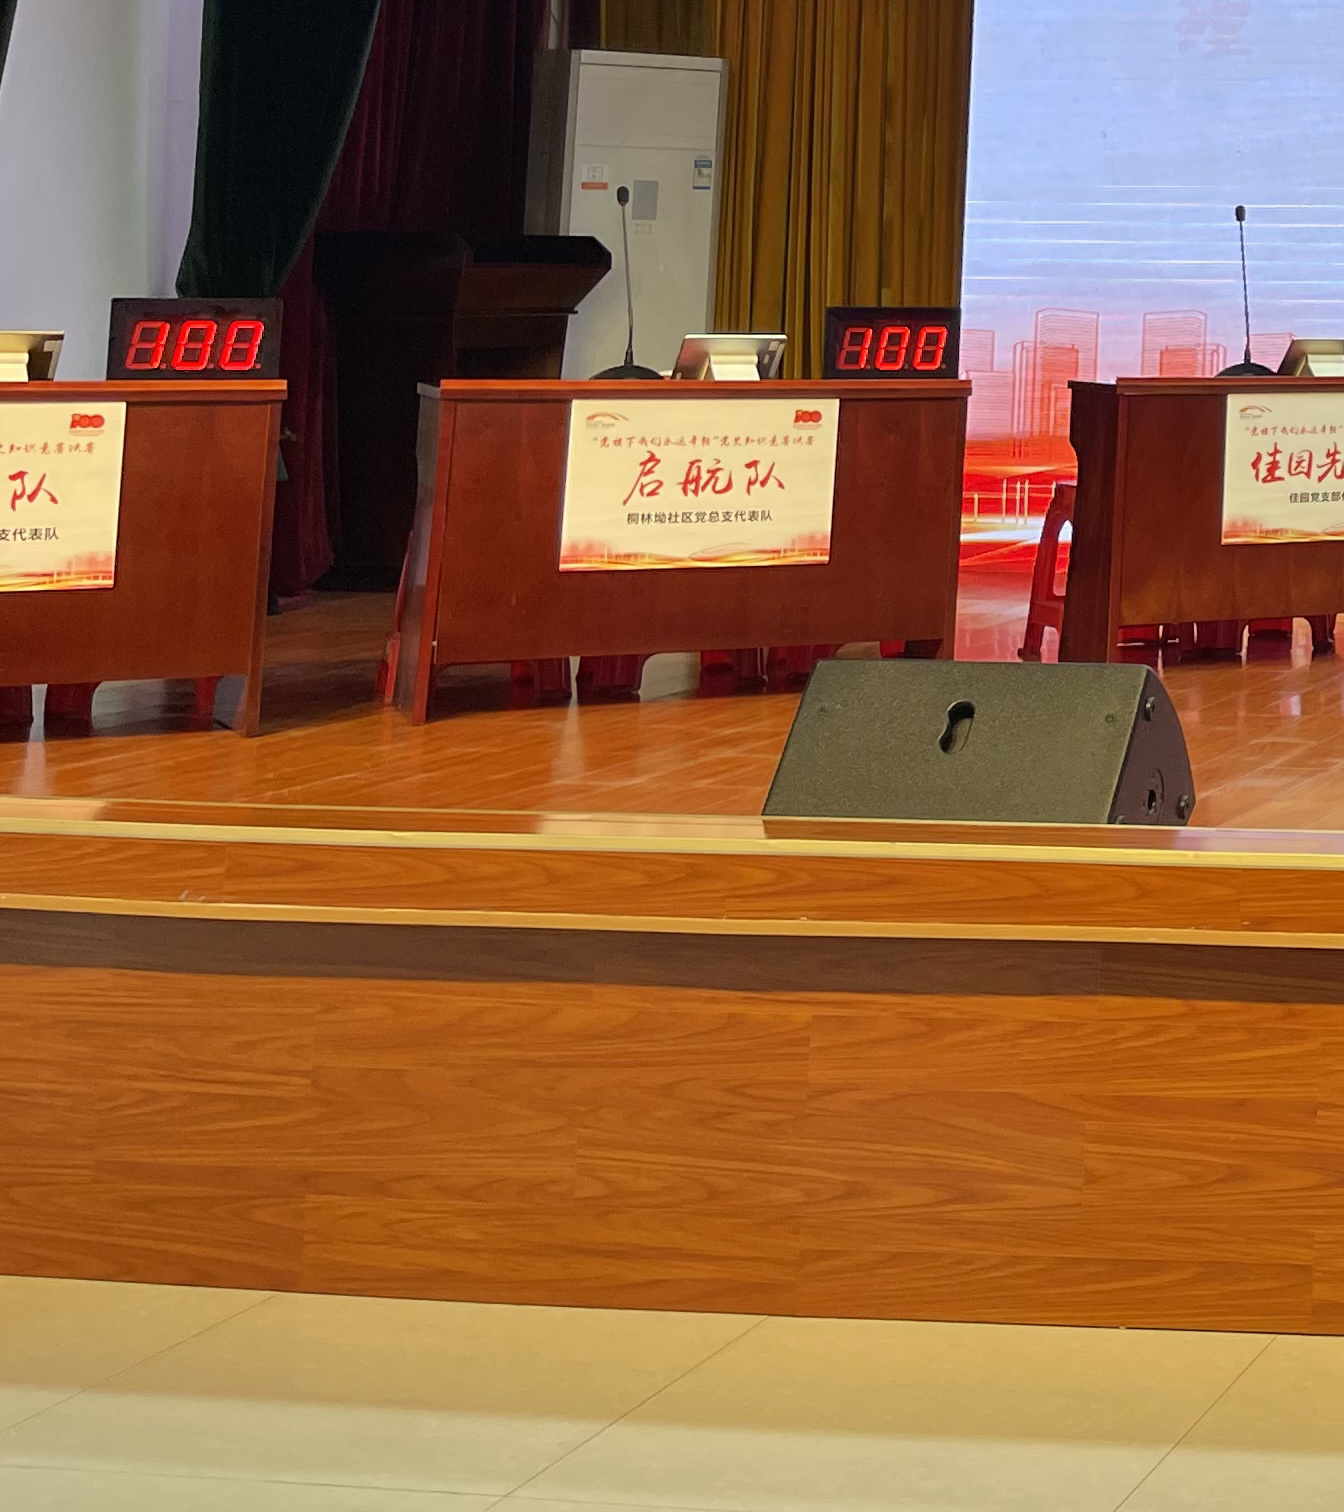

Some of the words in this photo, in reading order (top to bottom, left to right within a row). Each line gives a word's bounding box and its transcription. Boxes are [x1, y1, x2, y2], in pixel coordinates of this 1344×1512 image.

[124, 319, 265, 371] 100
[836, 325, 949, 371] 100
[8, 470, 59, 512] 队
[622, 450, 786, 506] 启航队
